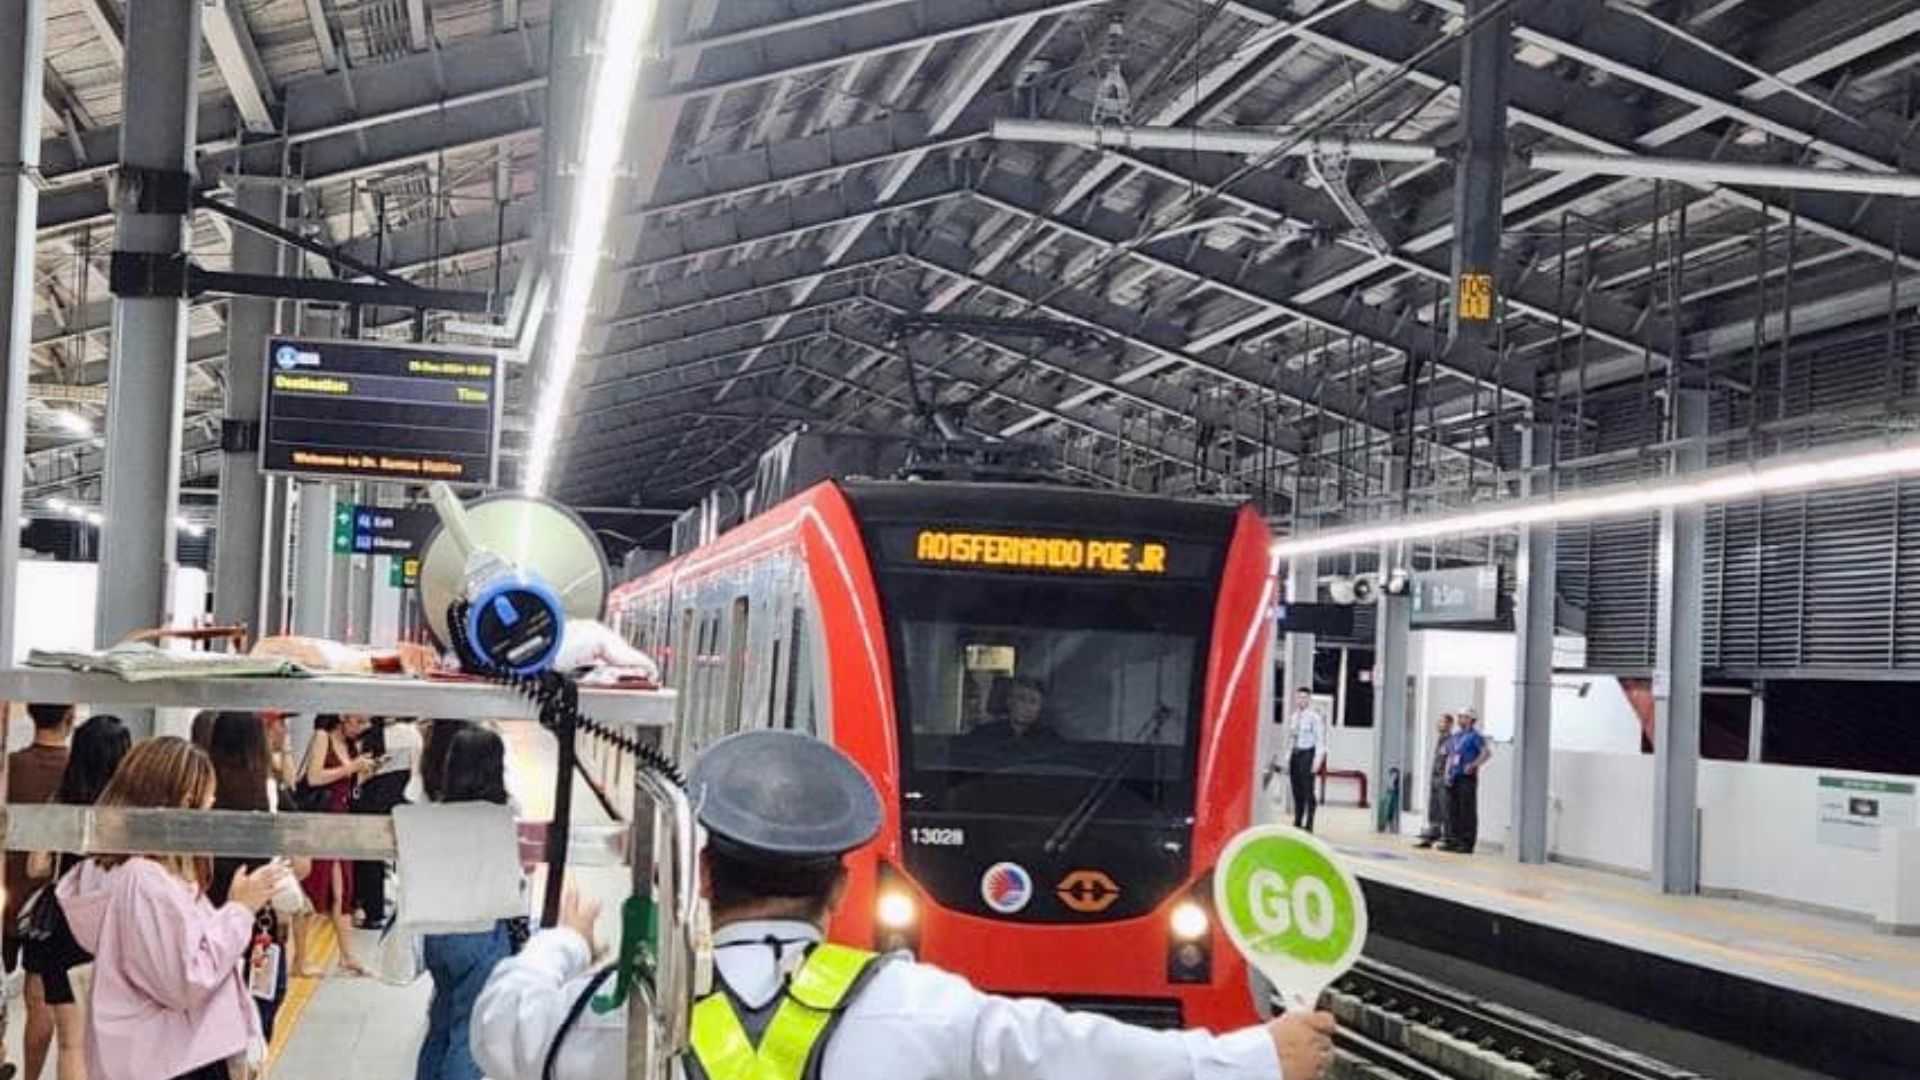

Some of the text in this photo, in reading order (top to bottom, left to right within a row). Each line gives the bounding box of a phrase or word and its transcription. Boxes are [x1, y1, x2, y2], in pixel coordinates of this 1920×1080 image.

[274, 374, 349, 392] Destination
[456, 387, 488, 401] Time
[373, 516, 394, 528] Exit
[1086, 540, 1132, 570] POE
[1136, 543, 1166, 573] JR
[1248, 868, 1334, 942] GO
